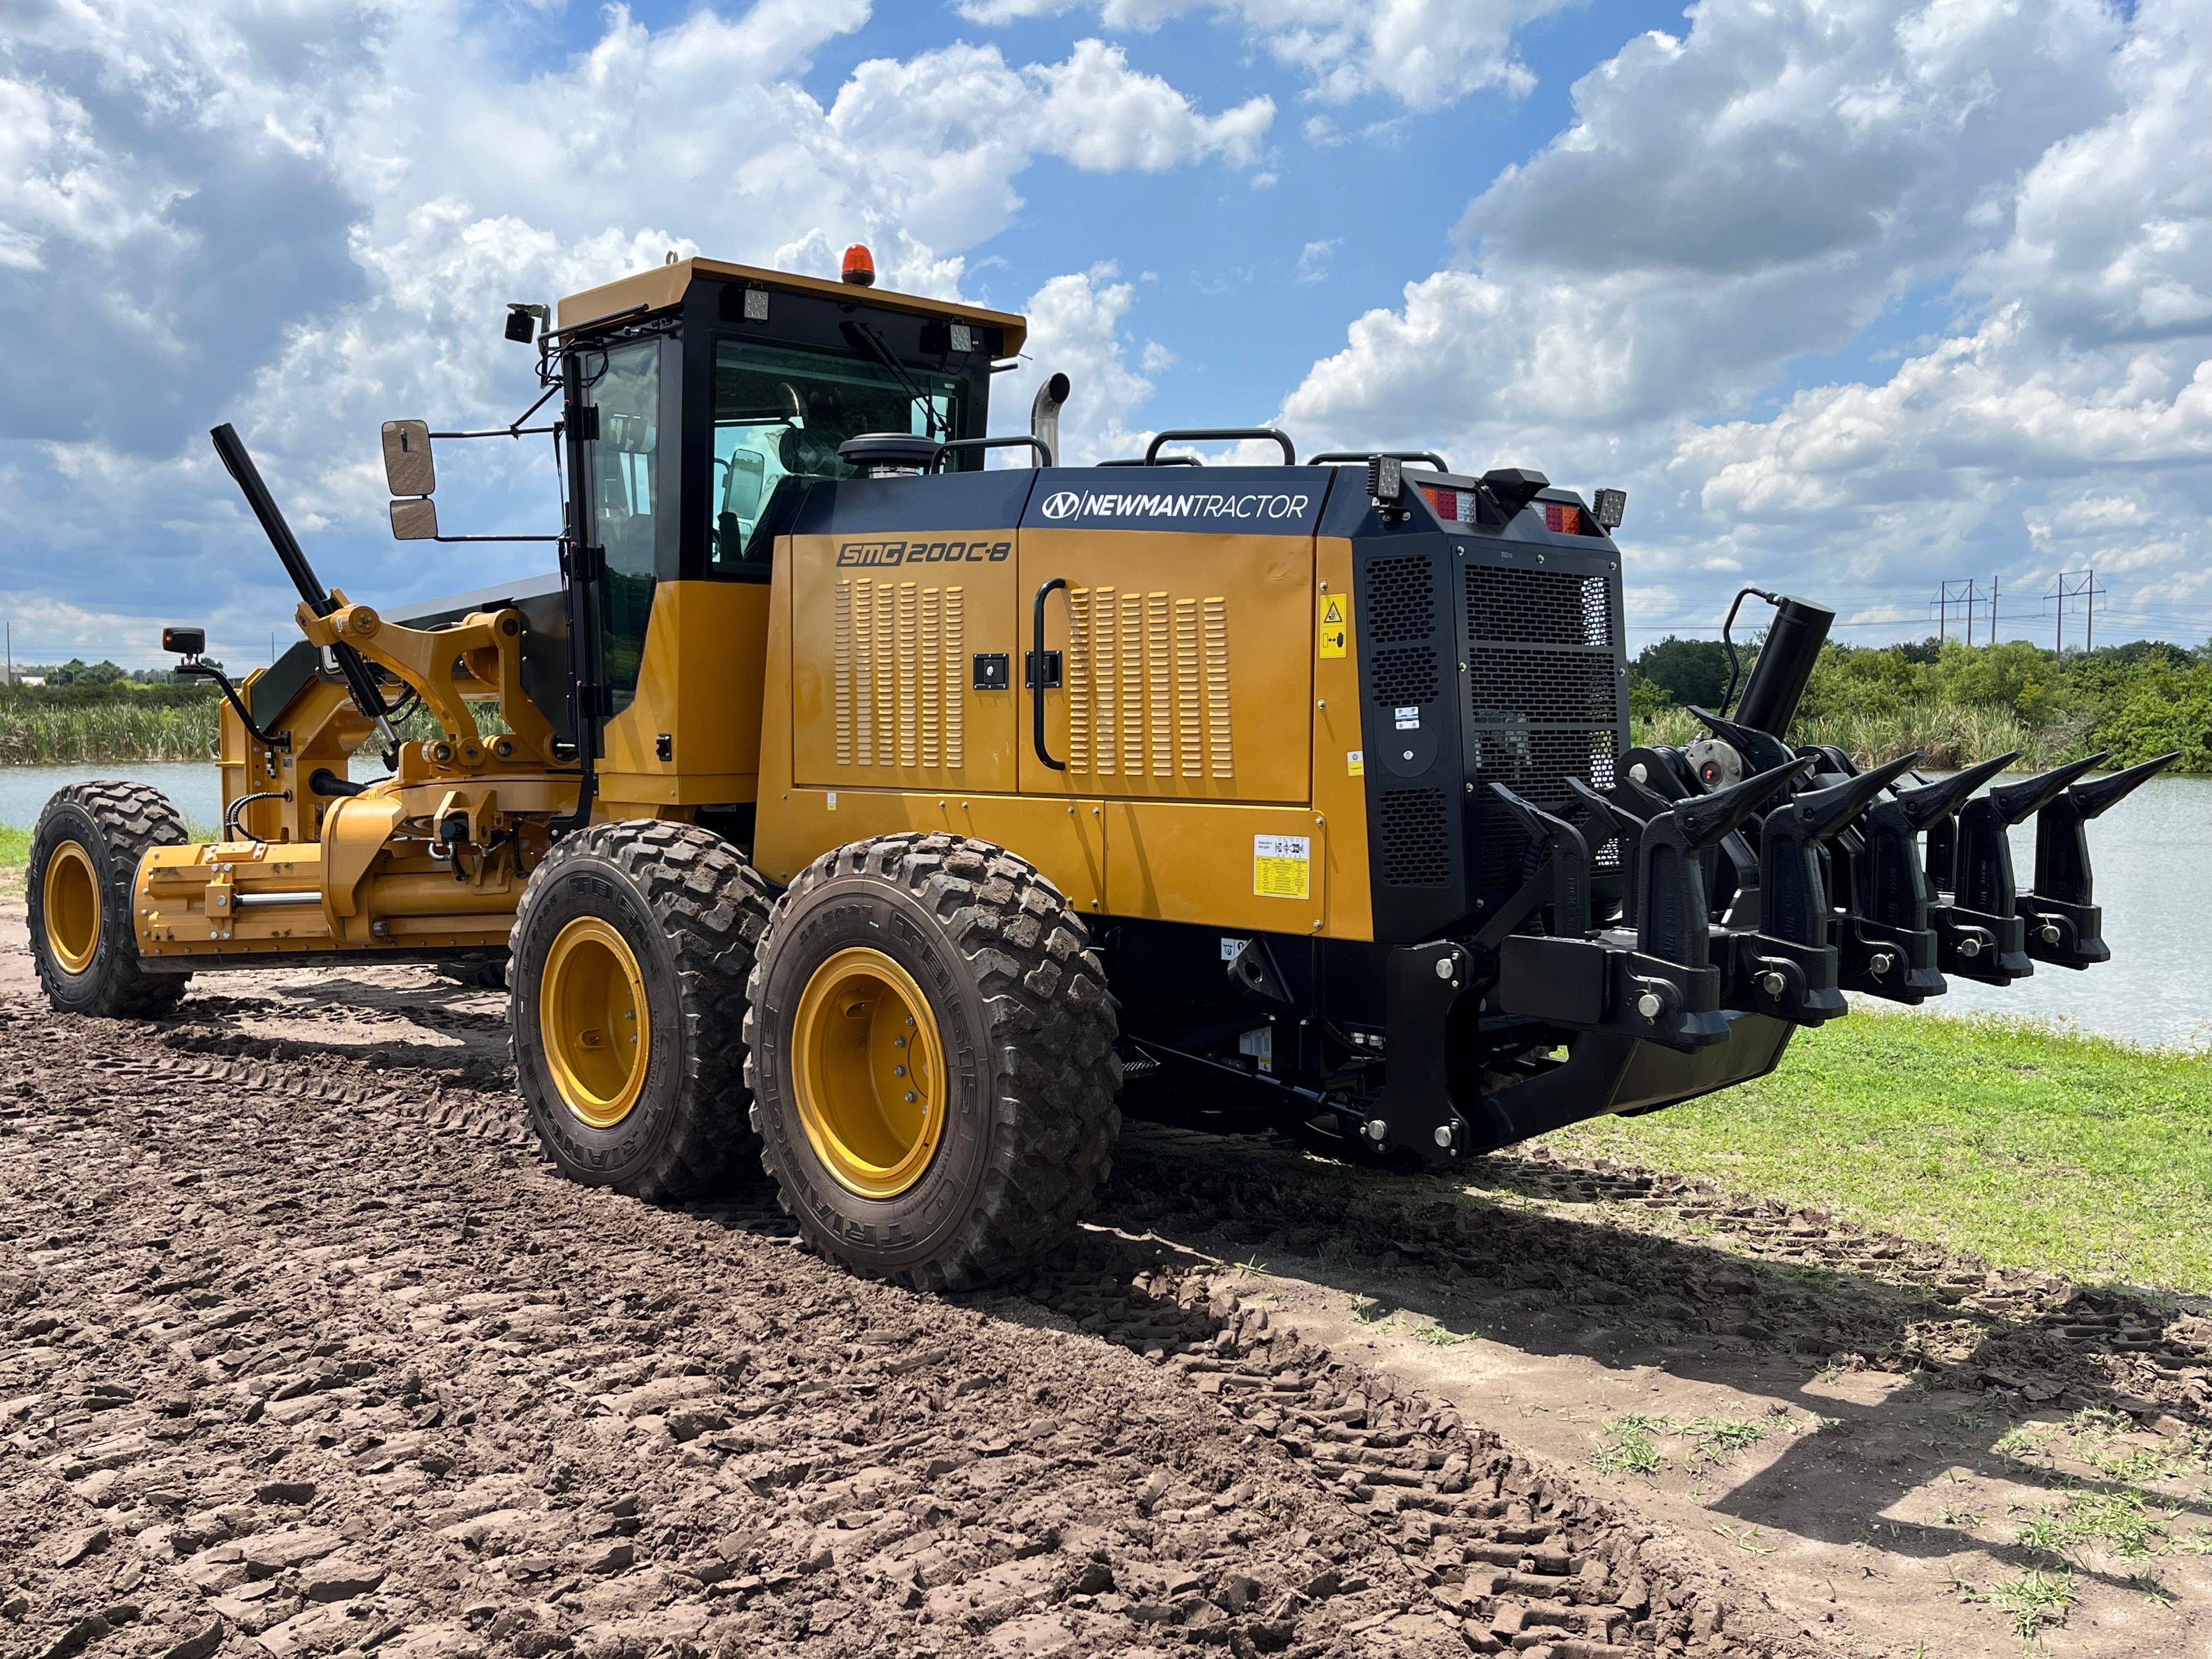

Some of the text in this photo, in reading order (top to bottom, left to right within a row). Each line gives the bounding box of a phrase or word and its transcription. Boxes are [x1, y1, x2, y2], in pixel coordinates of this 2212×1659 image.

[840, 544, 904, 565] SMG
[799, 904, 873, 946] 17.5R25
[764, 1004, 914, 1248] TRIANGLE
